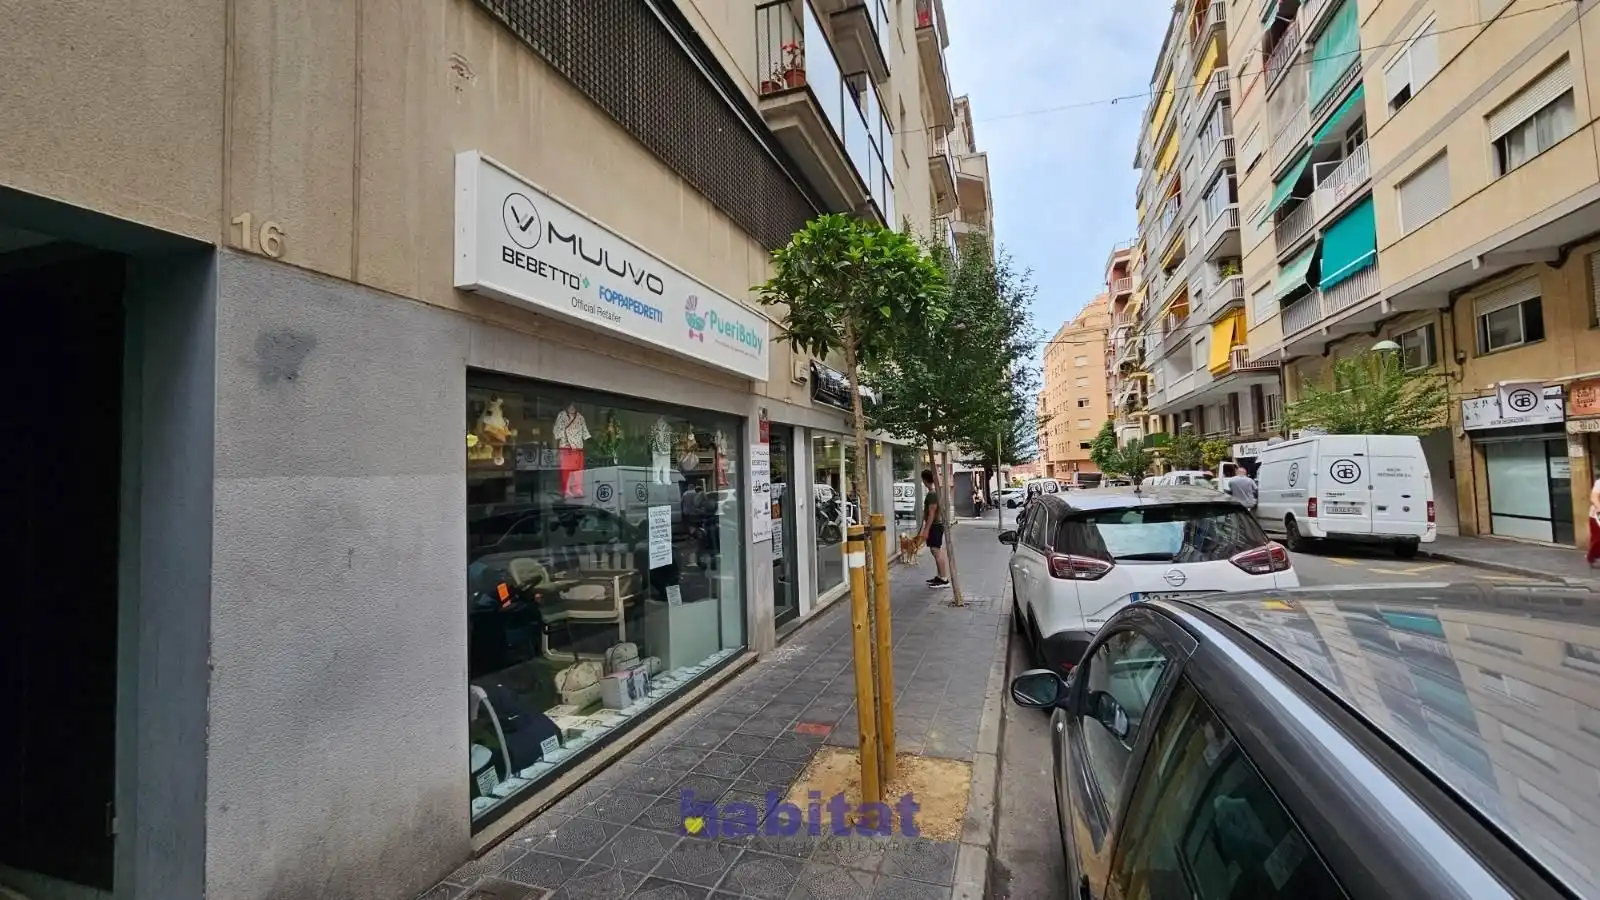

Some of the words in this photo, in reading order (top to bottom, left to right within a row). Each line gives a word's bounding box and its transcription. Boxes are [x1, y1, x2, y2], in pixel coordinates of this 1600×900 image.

[231, 212, 284, 258] 16
[502, 245, 580, 291] BEBETTO
[548, 222, 664, 296] MUUVO
[571, 296, 603, 314] Official
[596, 306, 622, 323] Retailer
[598, 286, 663, 324] FOPPAPEDRETTI
[709, 308, 763, 357] PueriBaby
